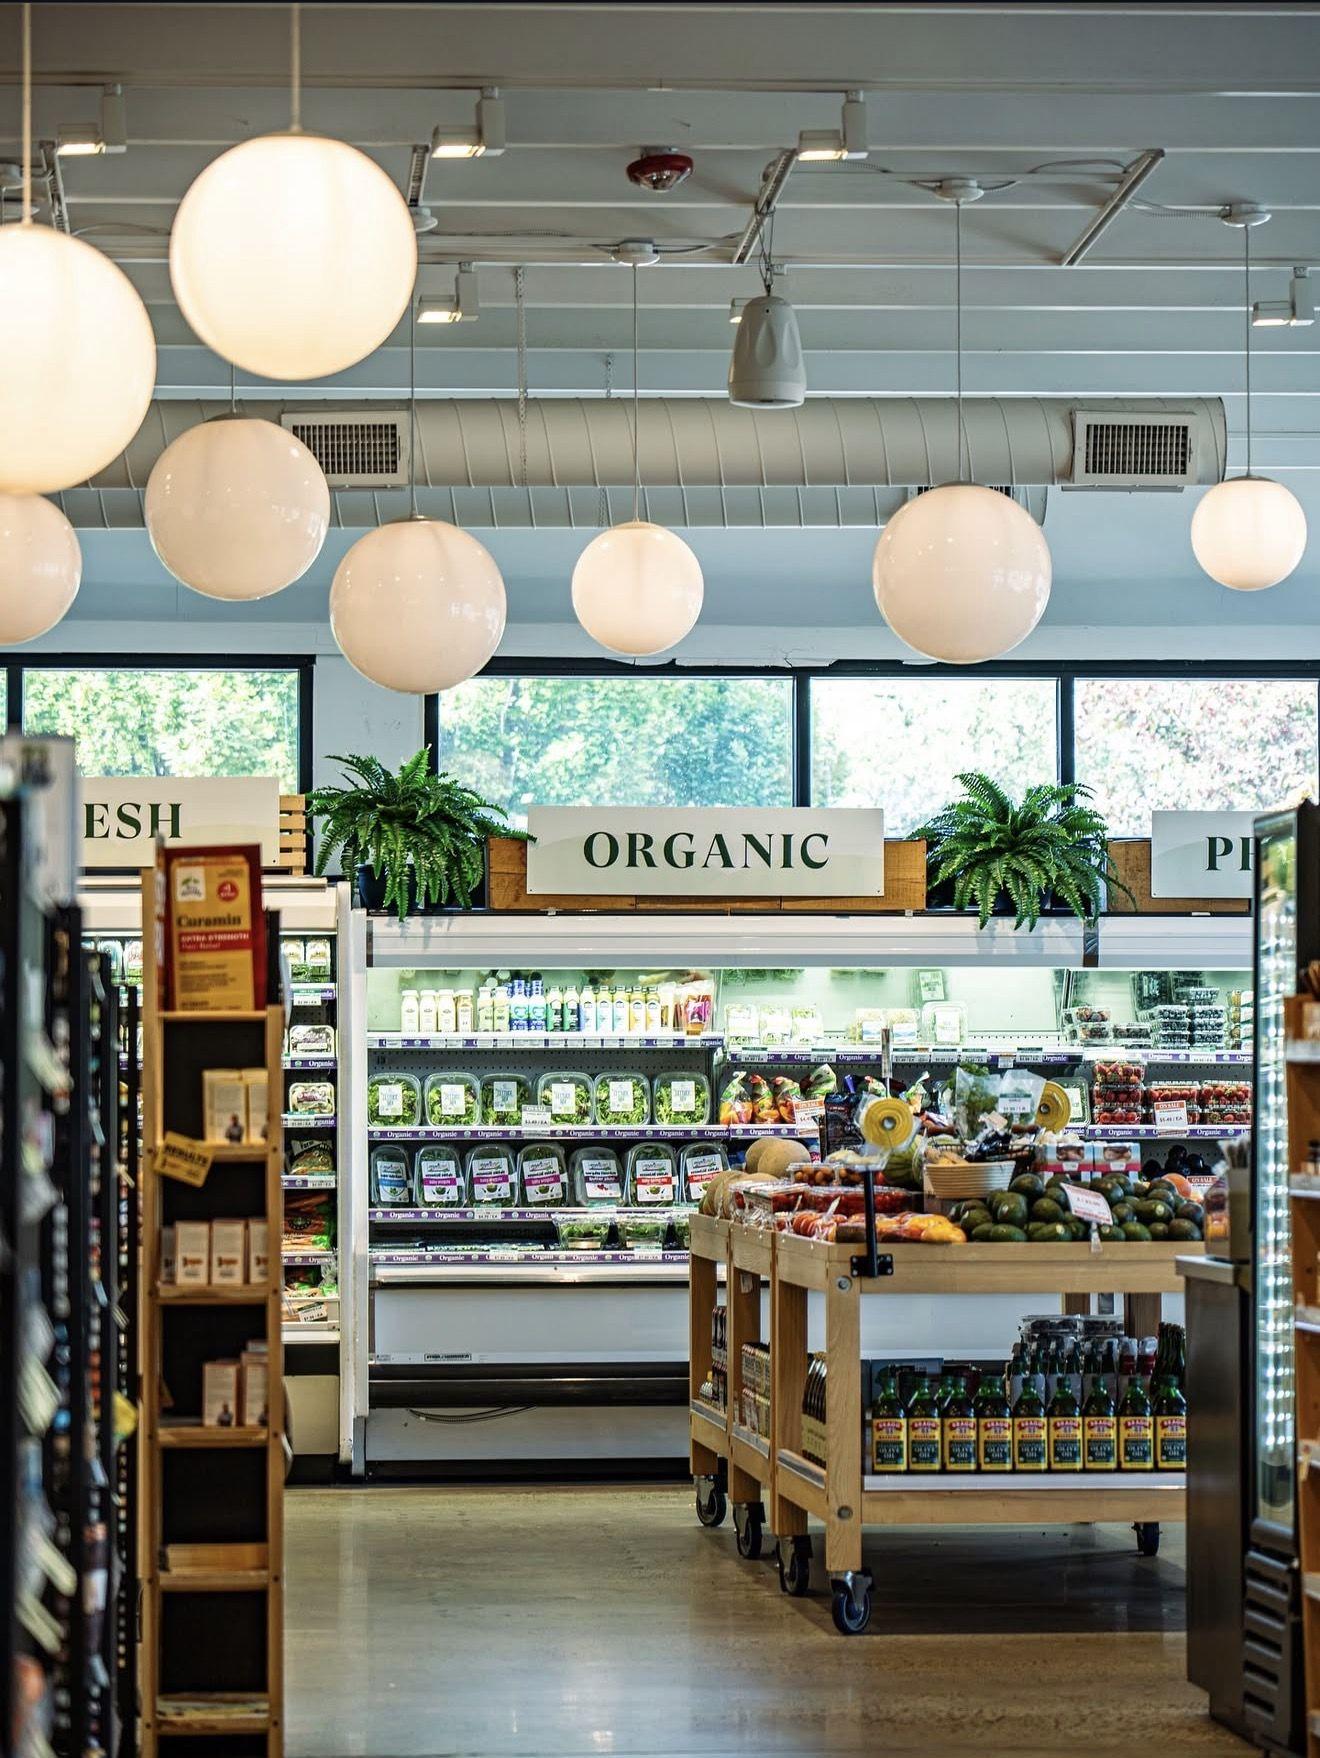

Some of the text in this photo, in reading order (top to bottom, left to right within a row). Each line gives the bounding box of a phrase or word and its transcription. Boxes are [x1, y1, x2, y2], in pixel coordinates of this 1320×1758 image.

[583, 831, 830, 869] ORGANIC
[387, 1130, 412, 1139] Organic
[433, 1130, 457, 1139] Organic
[478, 1130, 503, 1139] Organic
[570, 1130, 594, 1138] Organic
[615, 1130, 640, 1138] Organic
[660, 1130, 684, 1138] Organic
[705, 1129, 729, 1137] Organic
[750, 1128, 774, 1136] Organic
[1109, 1128, 1133, 1137] Organic
[1197, 1128, 1221, 1137] Organic
[390, 1210, 415, 1219] Organic
[435, 1210, 460, 1219] Organic
[440, 1253, 464, 1262] Organic
[573, 1253, 598, 1262] Organic
